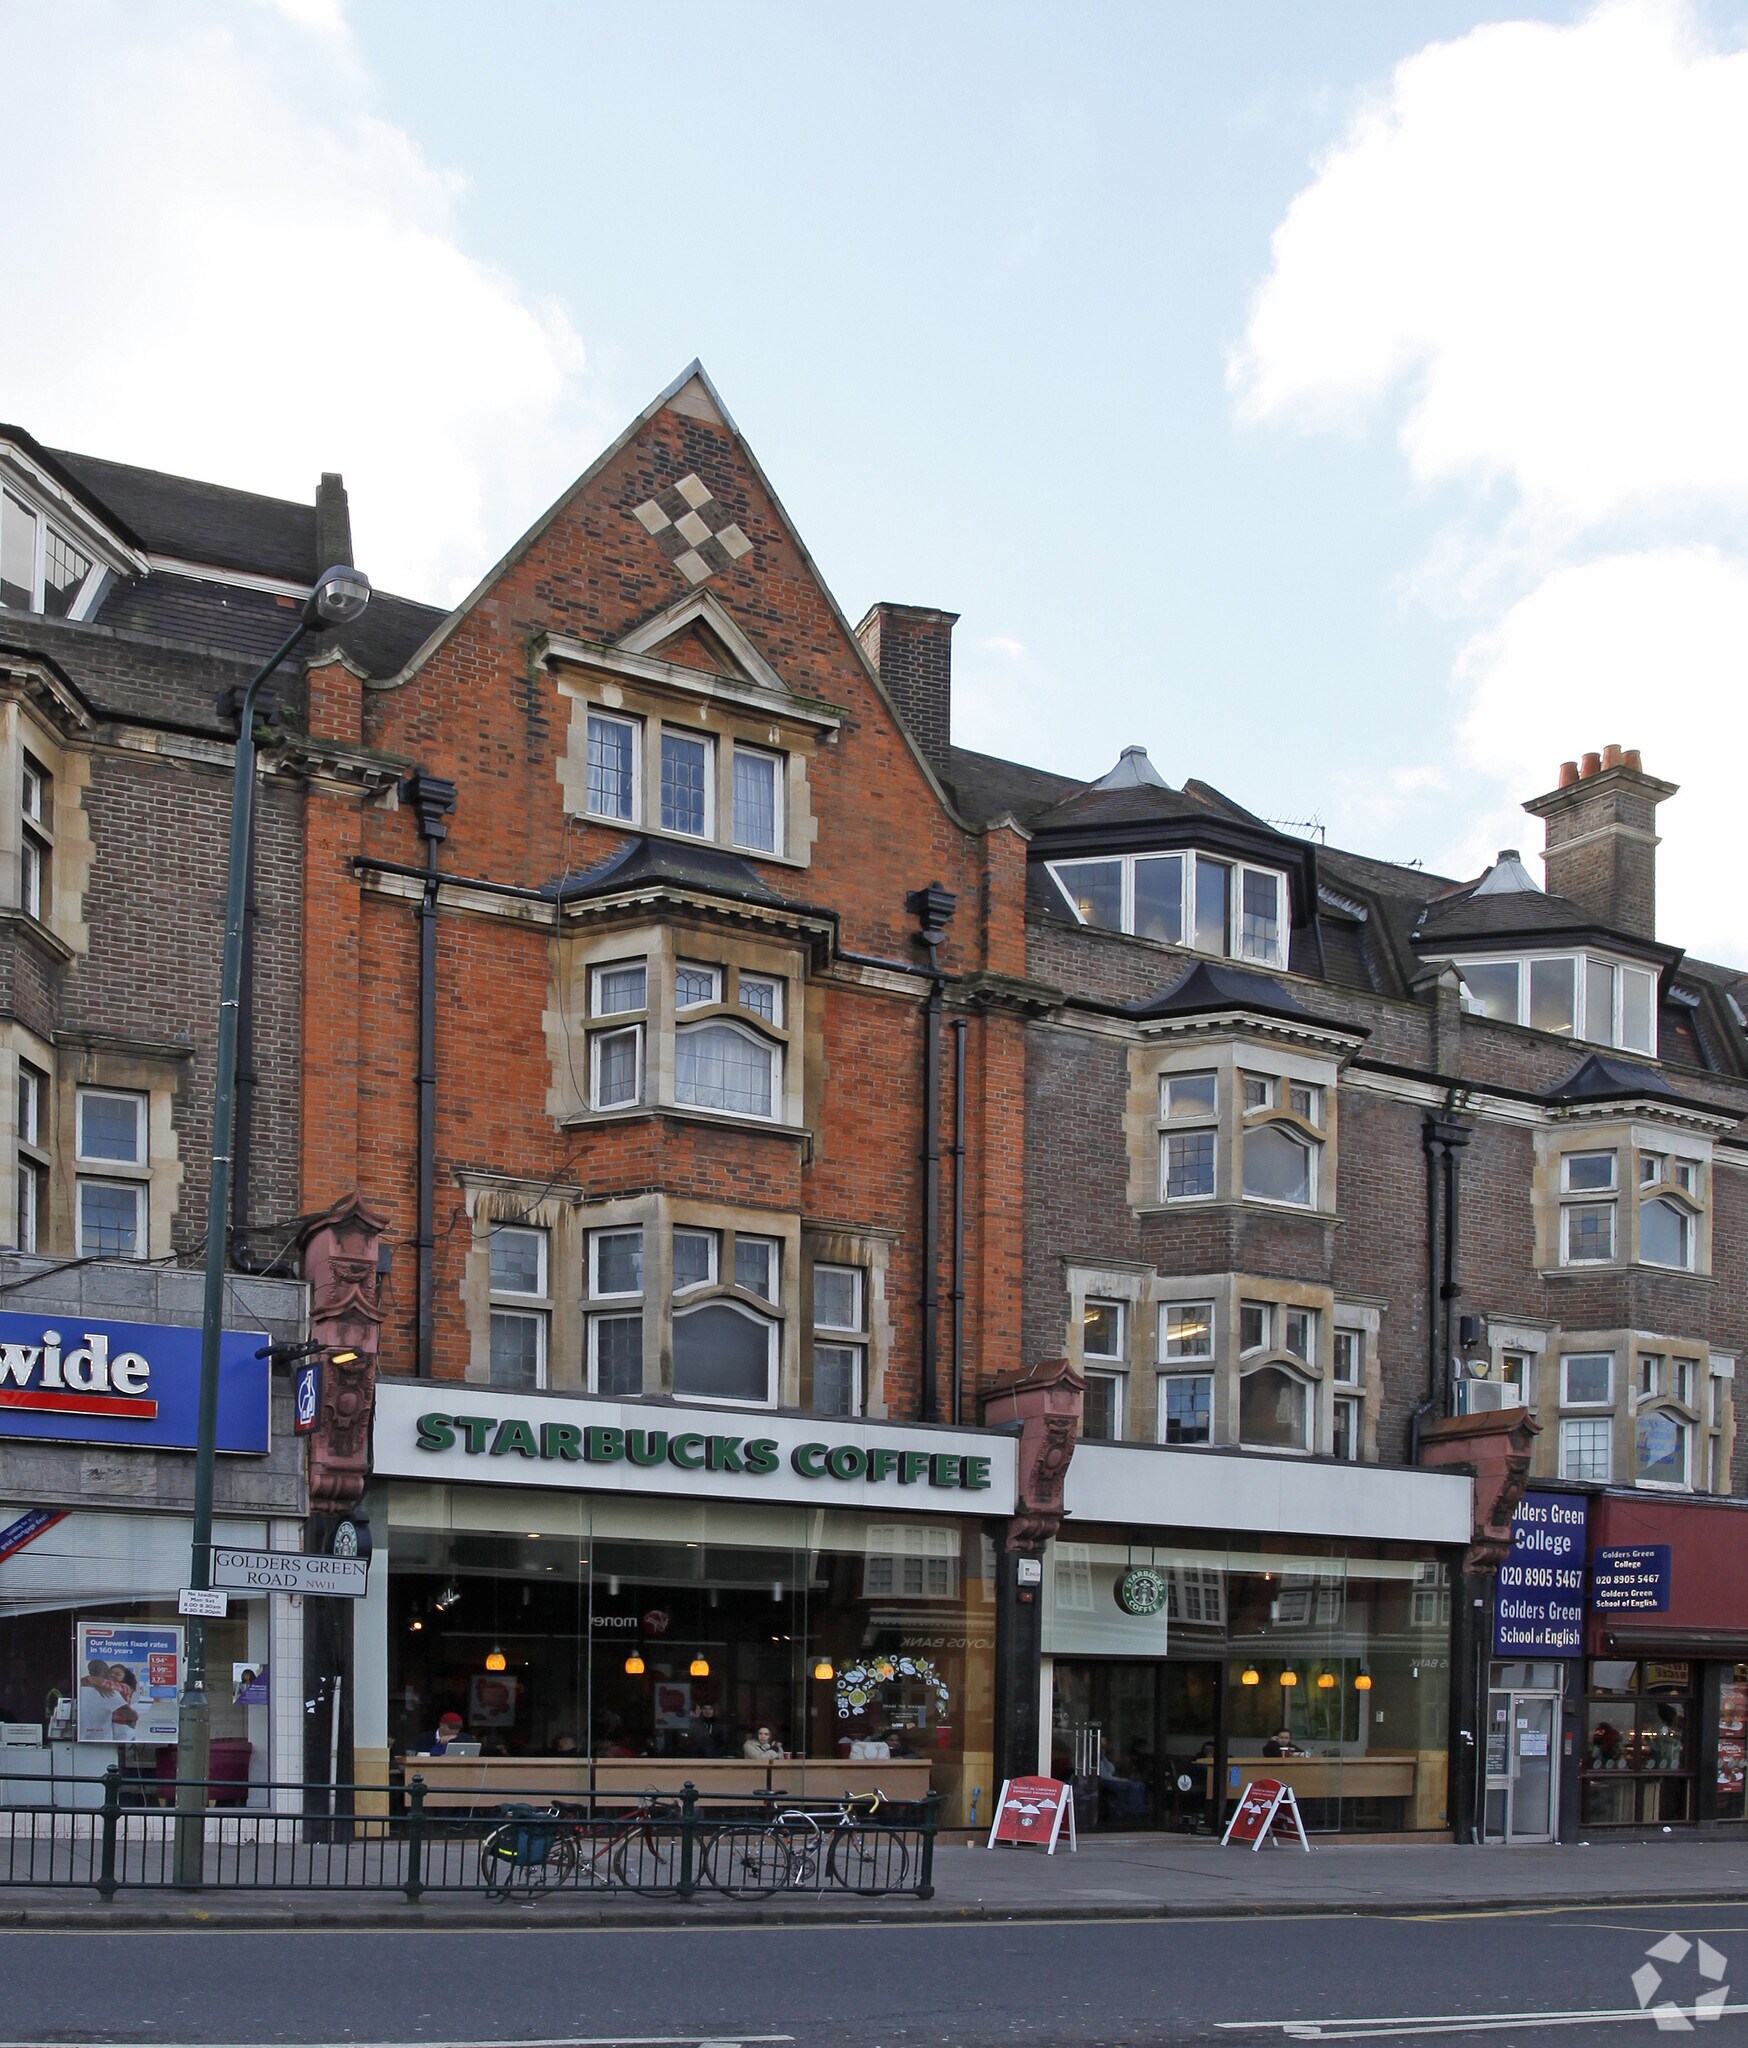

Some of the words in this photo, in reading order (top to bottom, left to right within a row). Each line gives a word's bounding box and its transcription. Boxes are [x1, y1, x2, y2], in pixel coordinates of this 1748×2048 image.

[416, 1412, 779, 1474] STARBUCKS
[791, 1442, 992, 1489] COFFEE
[1512, 1501, 1547, 1522] olders
[1551, 1504, 1584, 1524] Green
[1516, 1528, 1571, 1555] College
[216, 1553, 300, 1571] GOLDERS
[306, 1560, 366, 1576] GREEN
[1602, 1551, 1630, 1559] Golders
[1614, 1560, 1641, 1569] College
[247, 1572, 297, 1587] ROAD
[306, 1580, 335, 1590] NW11
[1125, 1570, 1165, 1591] STARBUCKS
[1501, 1566, 1522, 1585] 020
[1525, 1567, 1553, 1587] 8905
[1556, 1569, 1583, 1589] 5467
[1595, 1575, 1612, 1585] 020
[1613, 1575, 1635, 1584] 8905
[1637, 1574, 1660, 1583] 5467
[1596, 1600, 1620, 1608] School
[1630, 1599, 1658, 1608] English
[1601, 1590, 1629, 1598] Golders
[1630, 1589, 1653, 1597] Green
[1129, 1600, 1159, 1613] COFFEE
[1500, 1599, 1545, 1619] Golders
[1549, 1601, 1582, 1621] Green
[1500, 1626, 1534, 1643] School
[1535, 1632, 1543, 1643] of
[1545, 1628, 1580, 1647] English
